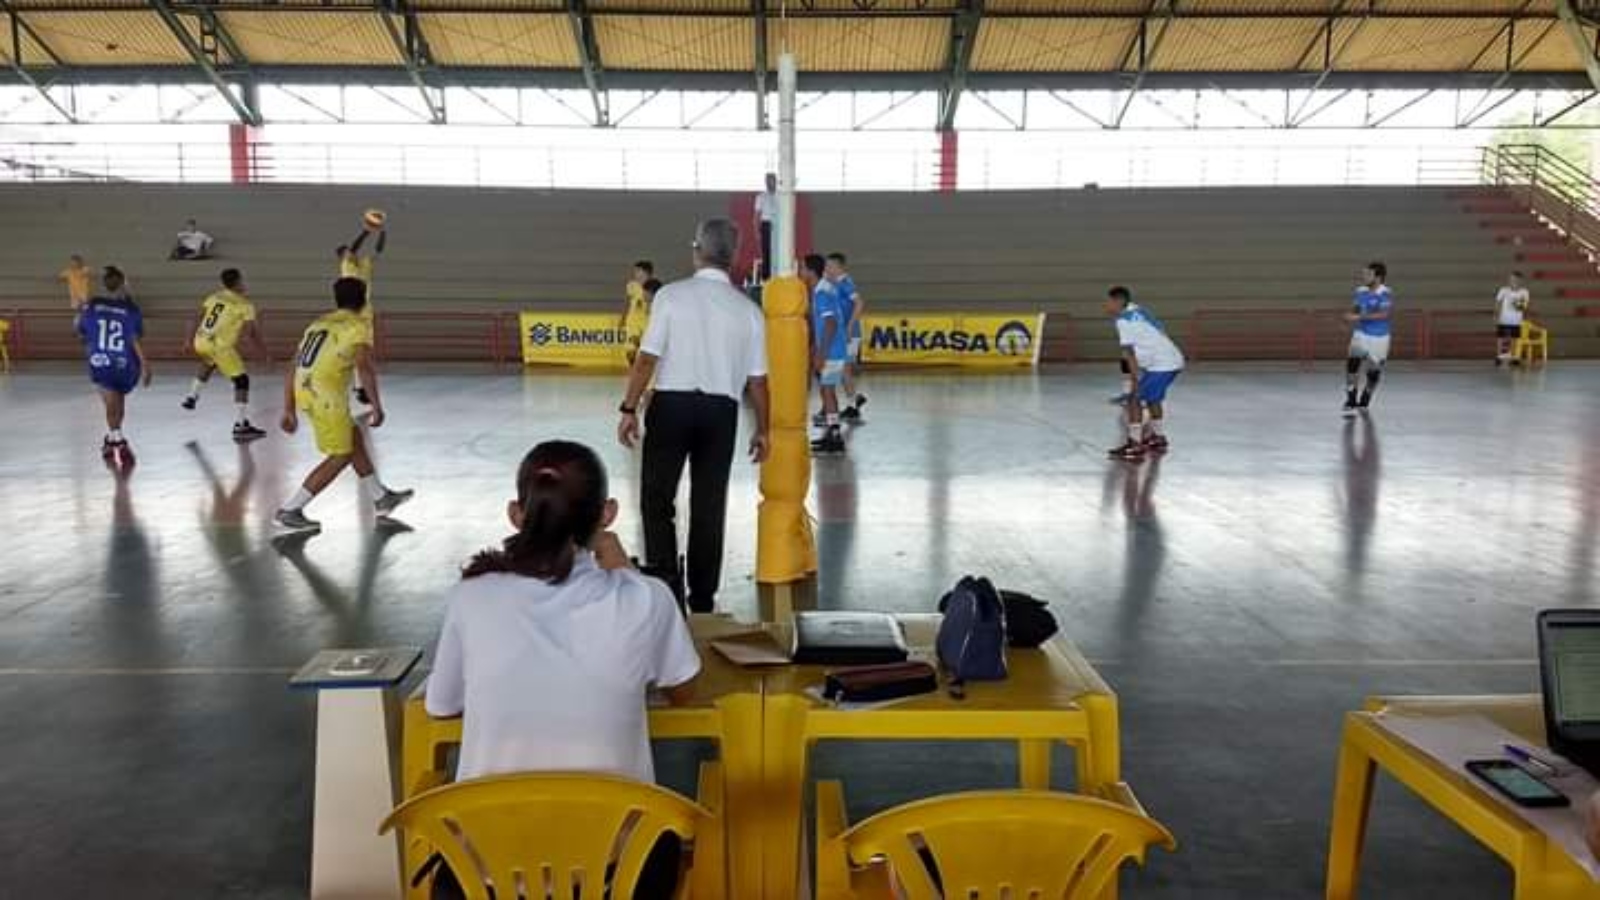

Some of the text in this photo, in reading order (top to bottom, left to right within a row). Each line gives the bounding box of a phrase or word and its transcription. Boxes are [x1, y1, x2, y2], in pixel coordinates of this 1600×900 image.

[205, 303, 225, 329] 5
[97, 319, 125, 351] 12
[299, 329, 328, 367] 10
[557, 326, 614, 343] BANCO
